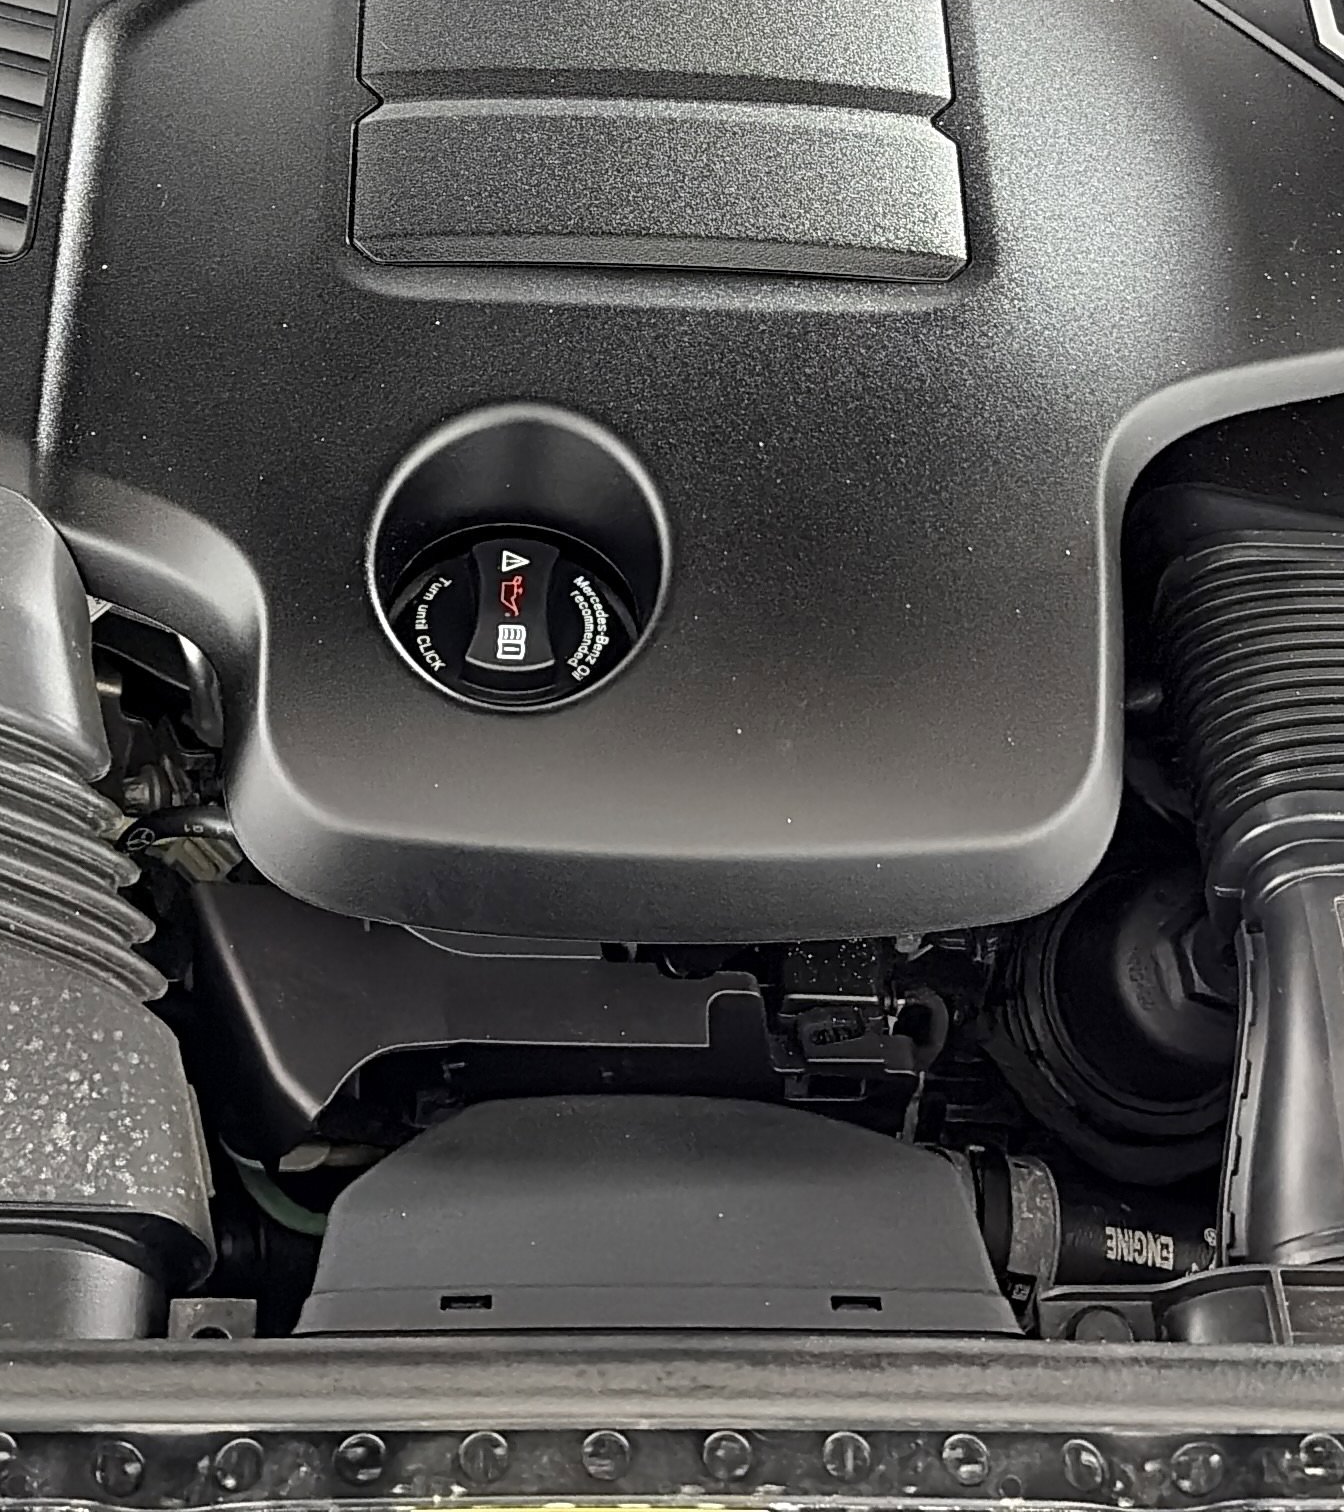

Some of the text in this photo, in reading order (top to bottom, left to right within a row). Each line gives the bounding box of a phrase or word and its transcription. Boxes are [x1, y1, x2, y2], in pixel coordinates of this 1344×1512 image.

[415, 577, 453, 671] Turn until CLICK
[567, 590, 595, 667] recommended
[571, 575, 610, 681] Mercedes-Benz Oil
[1105, 1226, 1174, 1271] ENGINE
